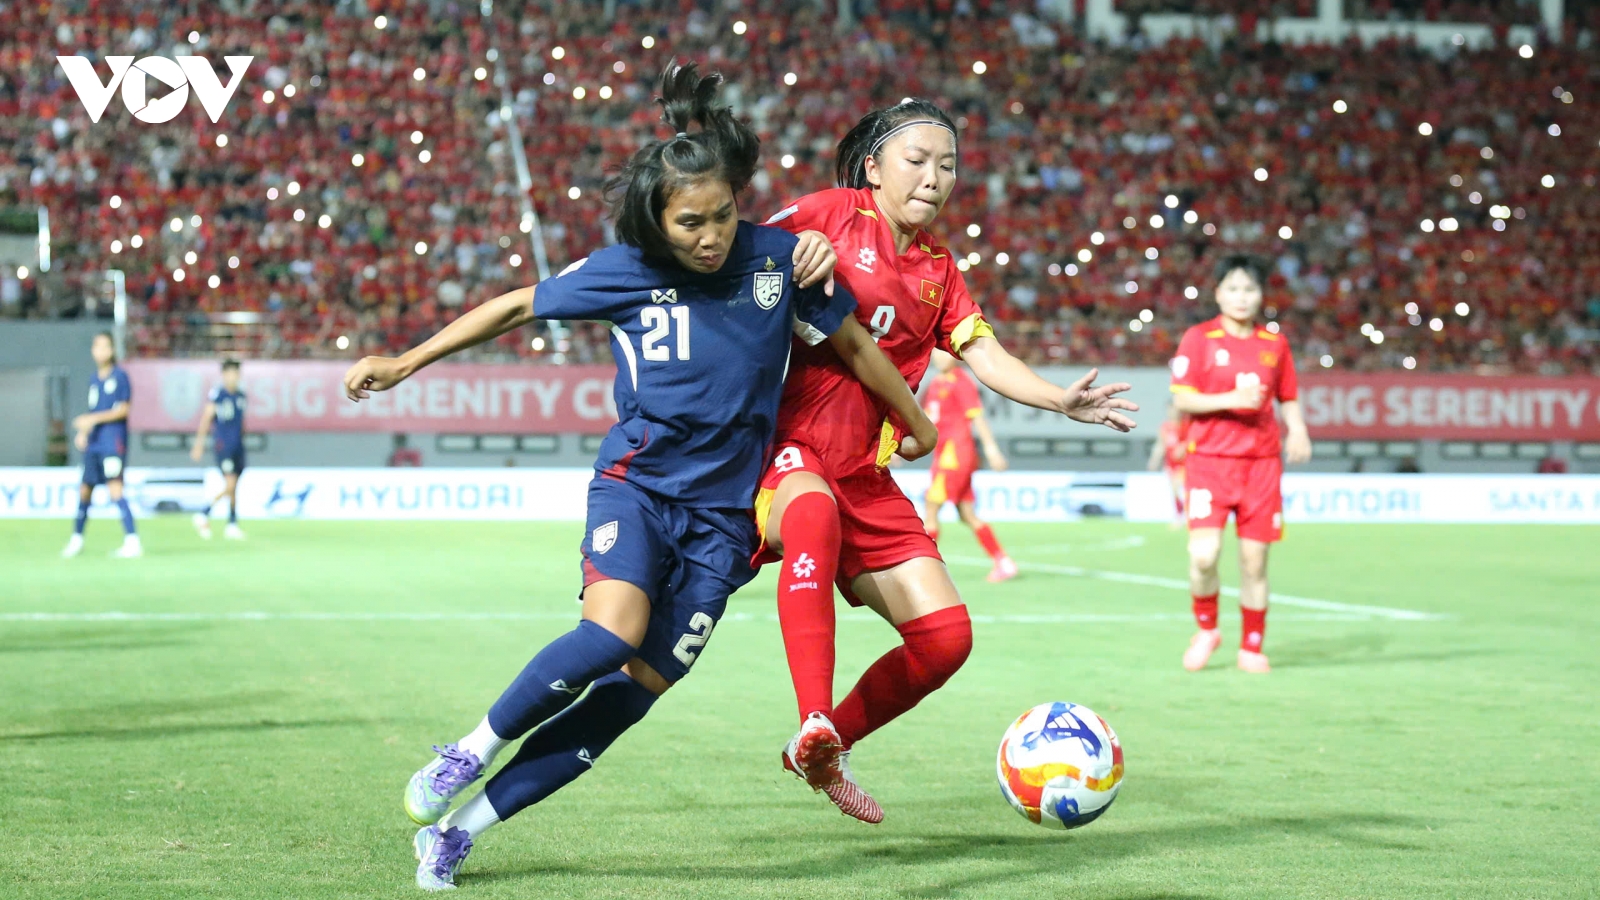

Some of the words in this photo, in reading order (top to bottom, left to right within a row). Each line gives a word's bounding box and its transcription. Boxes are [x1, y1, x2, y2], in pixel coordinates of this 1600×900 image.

[641, 306, 690, 361] 21
[871, 306, 895, 343] 9
[241, 377, 327, 418] SIG
[1298, 385, 1376, 427] SIG
[1384, 385, 1590, 428] SERENITY
[775, 446, 805, 473] 9
[339, 483, 524, 510] HYUNDAI
[1280, 487, 1422, 513] YUNDAI
